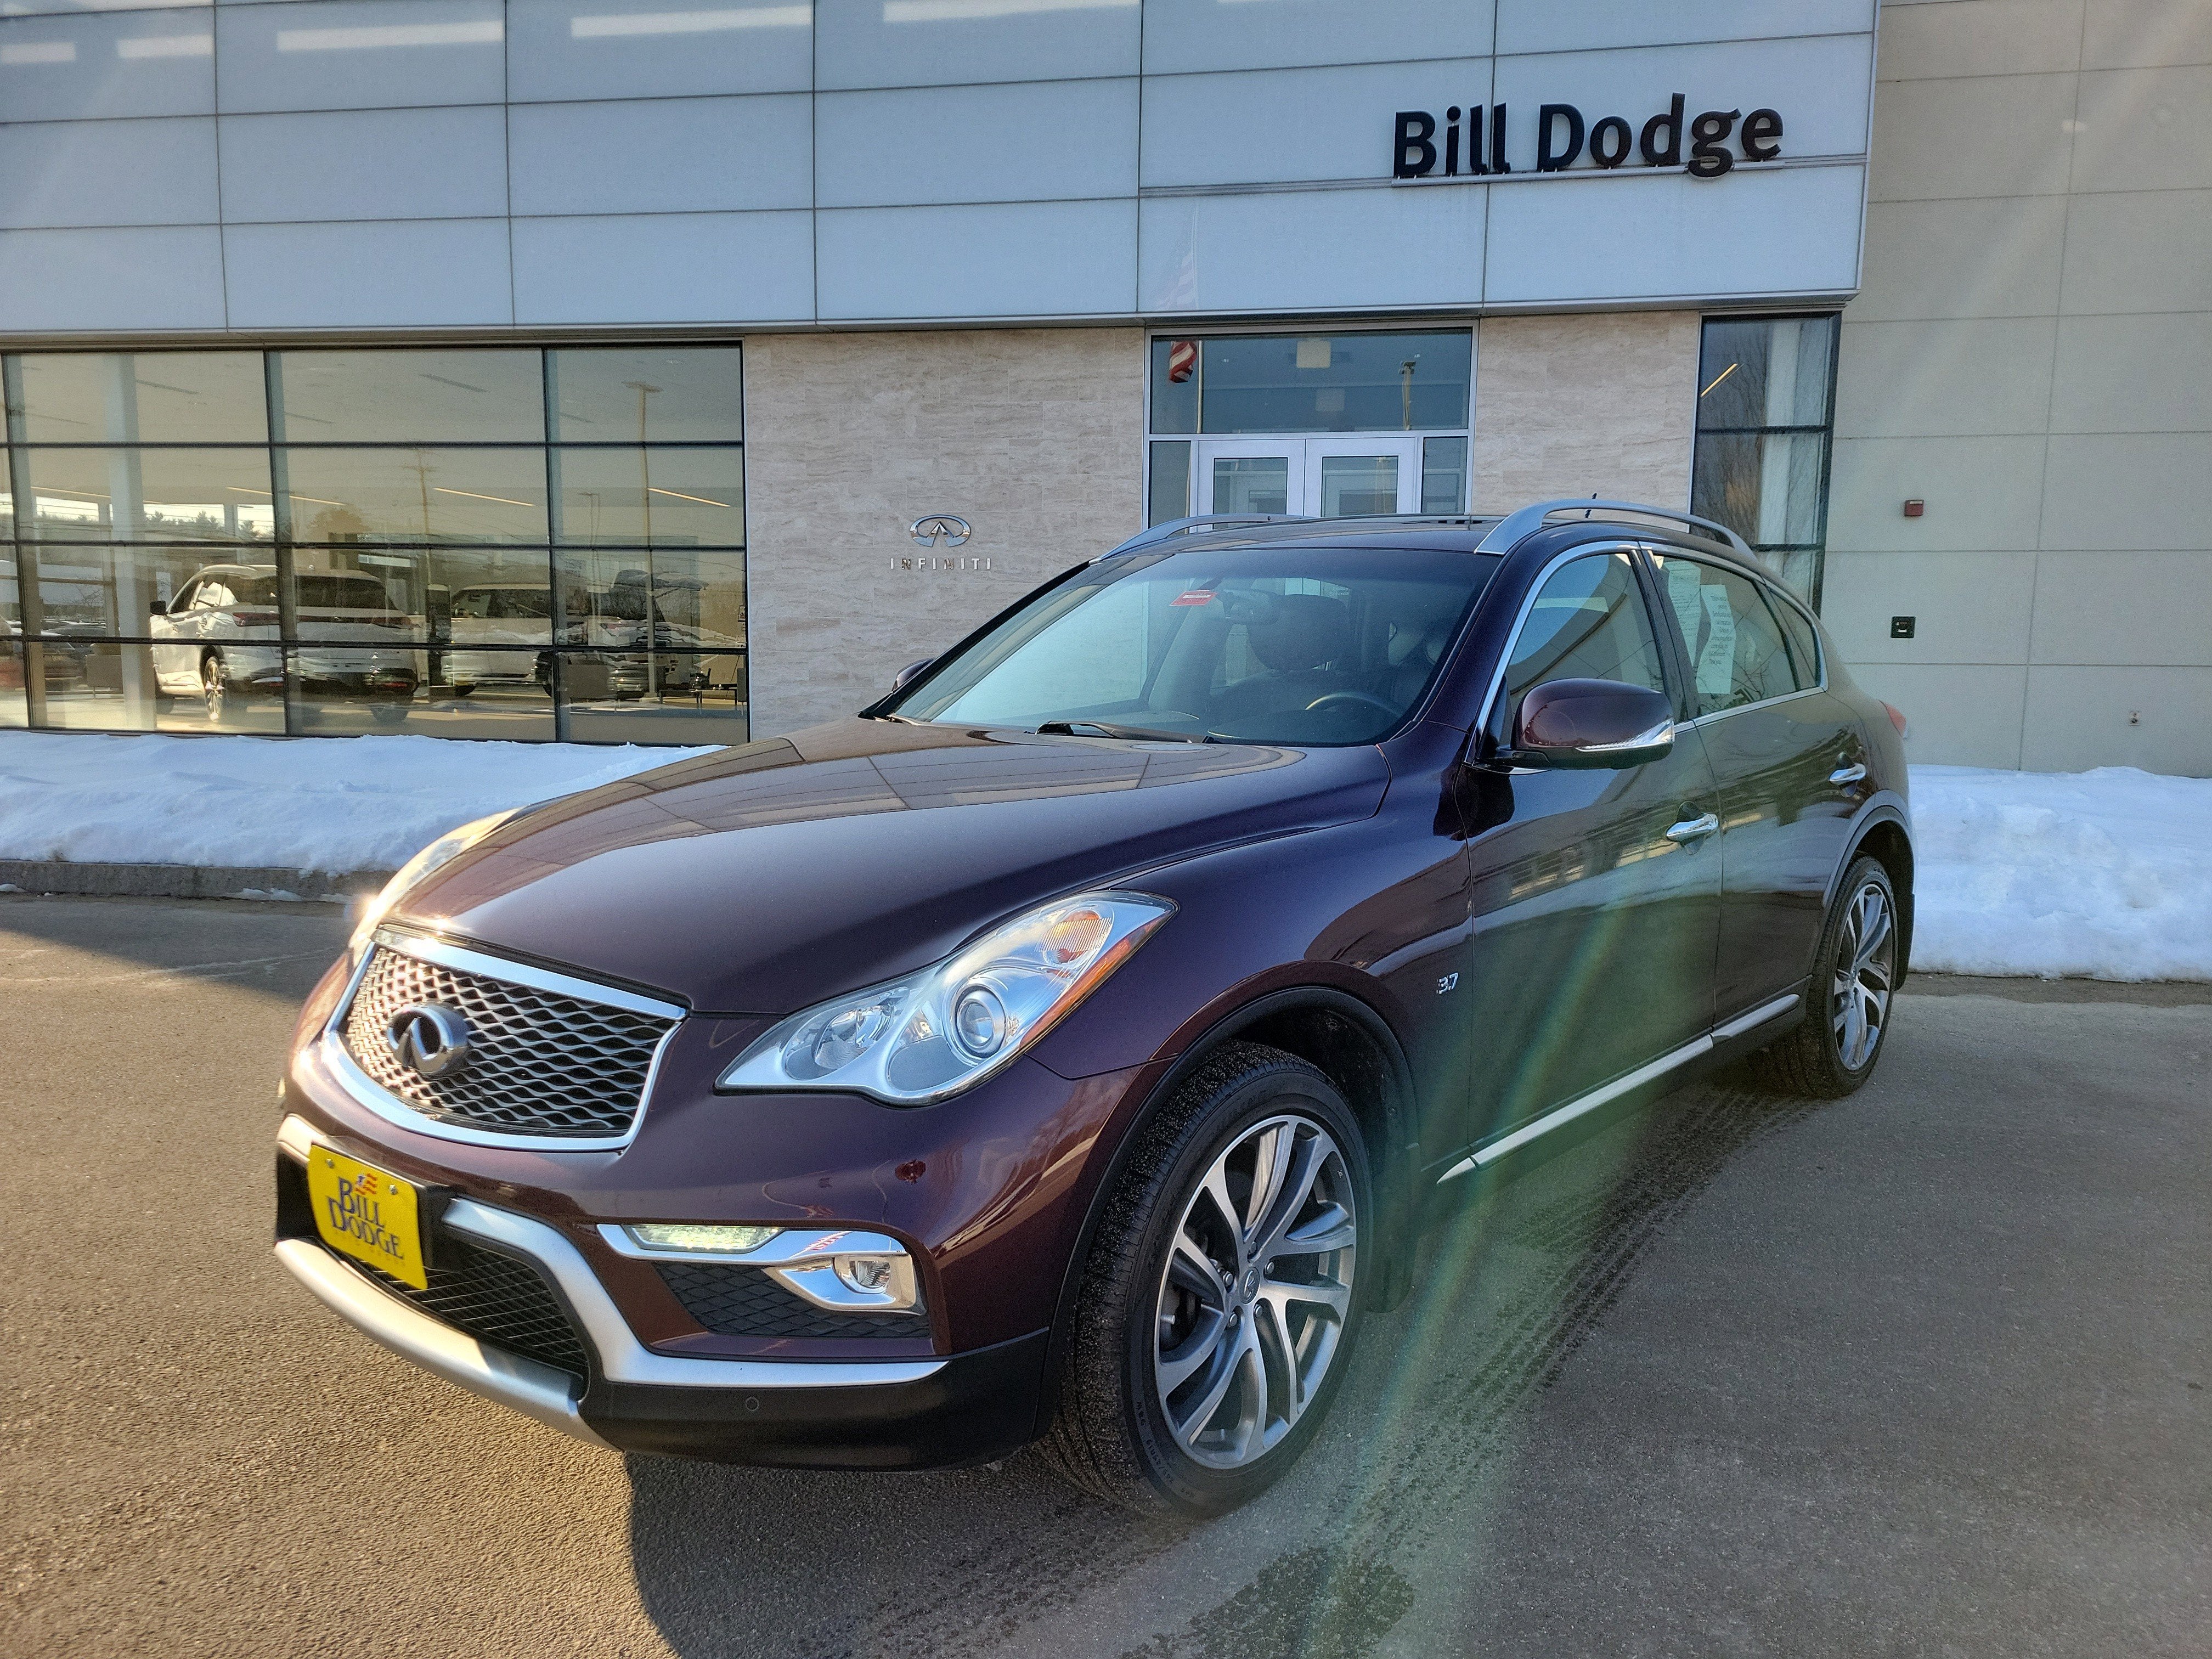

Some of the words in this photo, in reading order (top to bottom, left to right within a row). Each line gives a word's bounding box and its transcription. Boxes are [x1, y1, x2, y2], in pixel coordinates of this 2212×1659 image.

[1393, 102, 1511, 177] Bill
[1536, 92, 1784, 178] Dodge
[890, 557, 991, 571] INFINITI
[328, 1196, 404, 1260] DODGE
[338, 1177, 385, 1227] BILL
